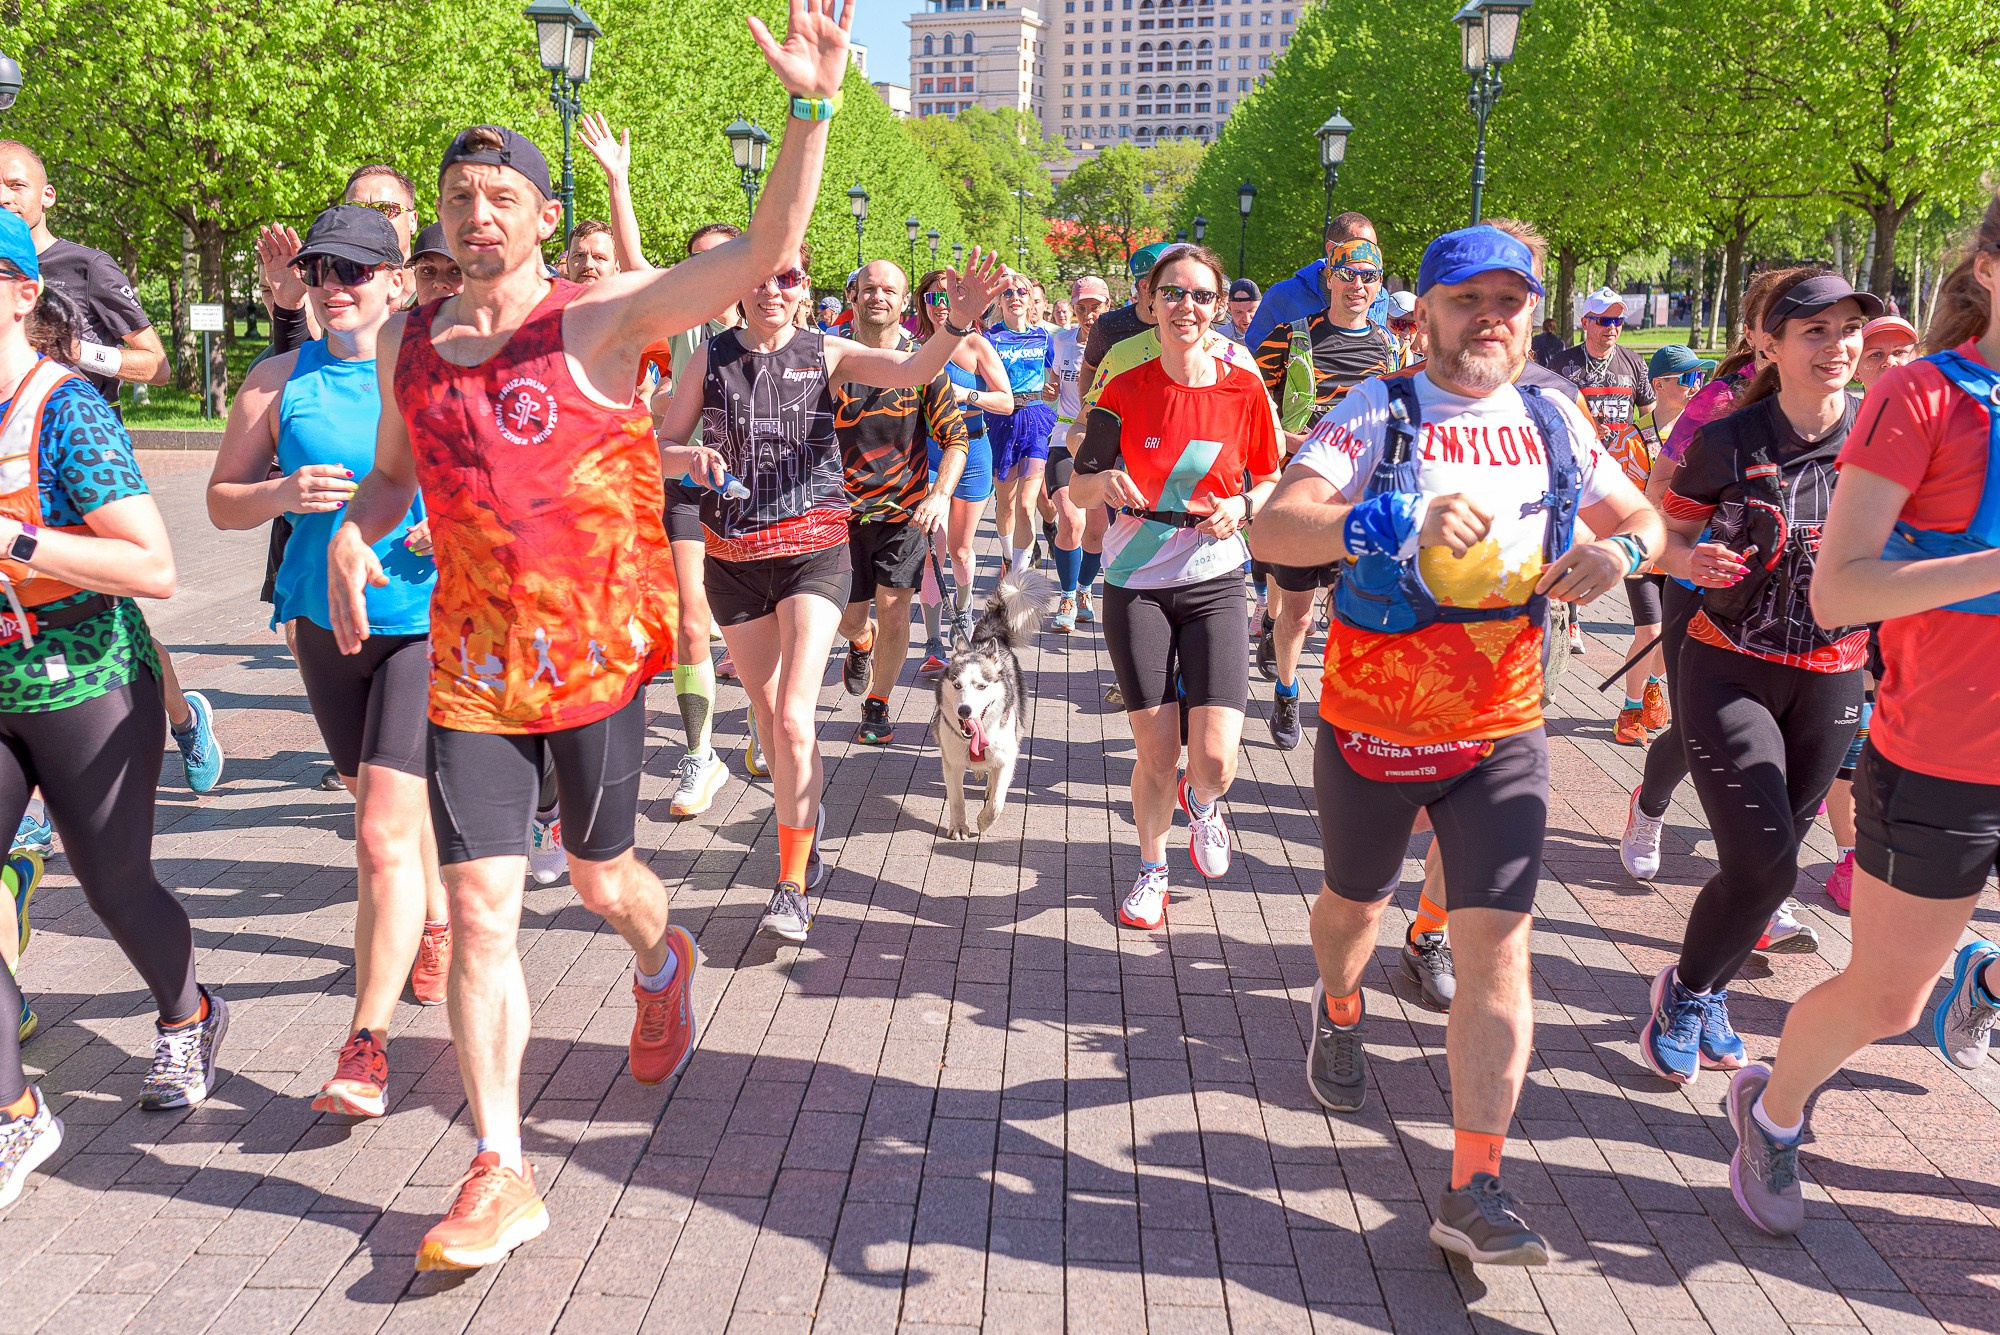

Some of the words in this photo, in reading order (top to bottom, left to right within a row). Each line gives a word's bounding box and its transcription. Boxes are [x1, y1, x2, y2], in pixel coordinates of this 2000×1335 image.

[1422, 421, 1543, 466] ZMYLON
[1367, 744, 1412, 758] ULTRA
[1414, 742, 1458, 756] TRAIL
